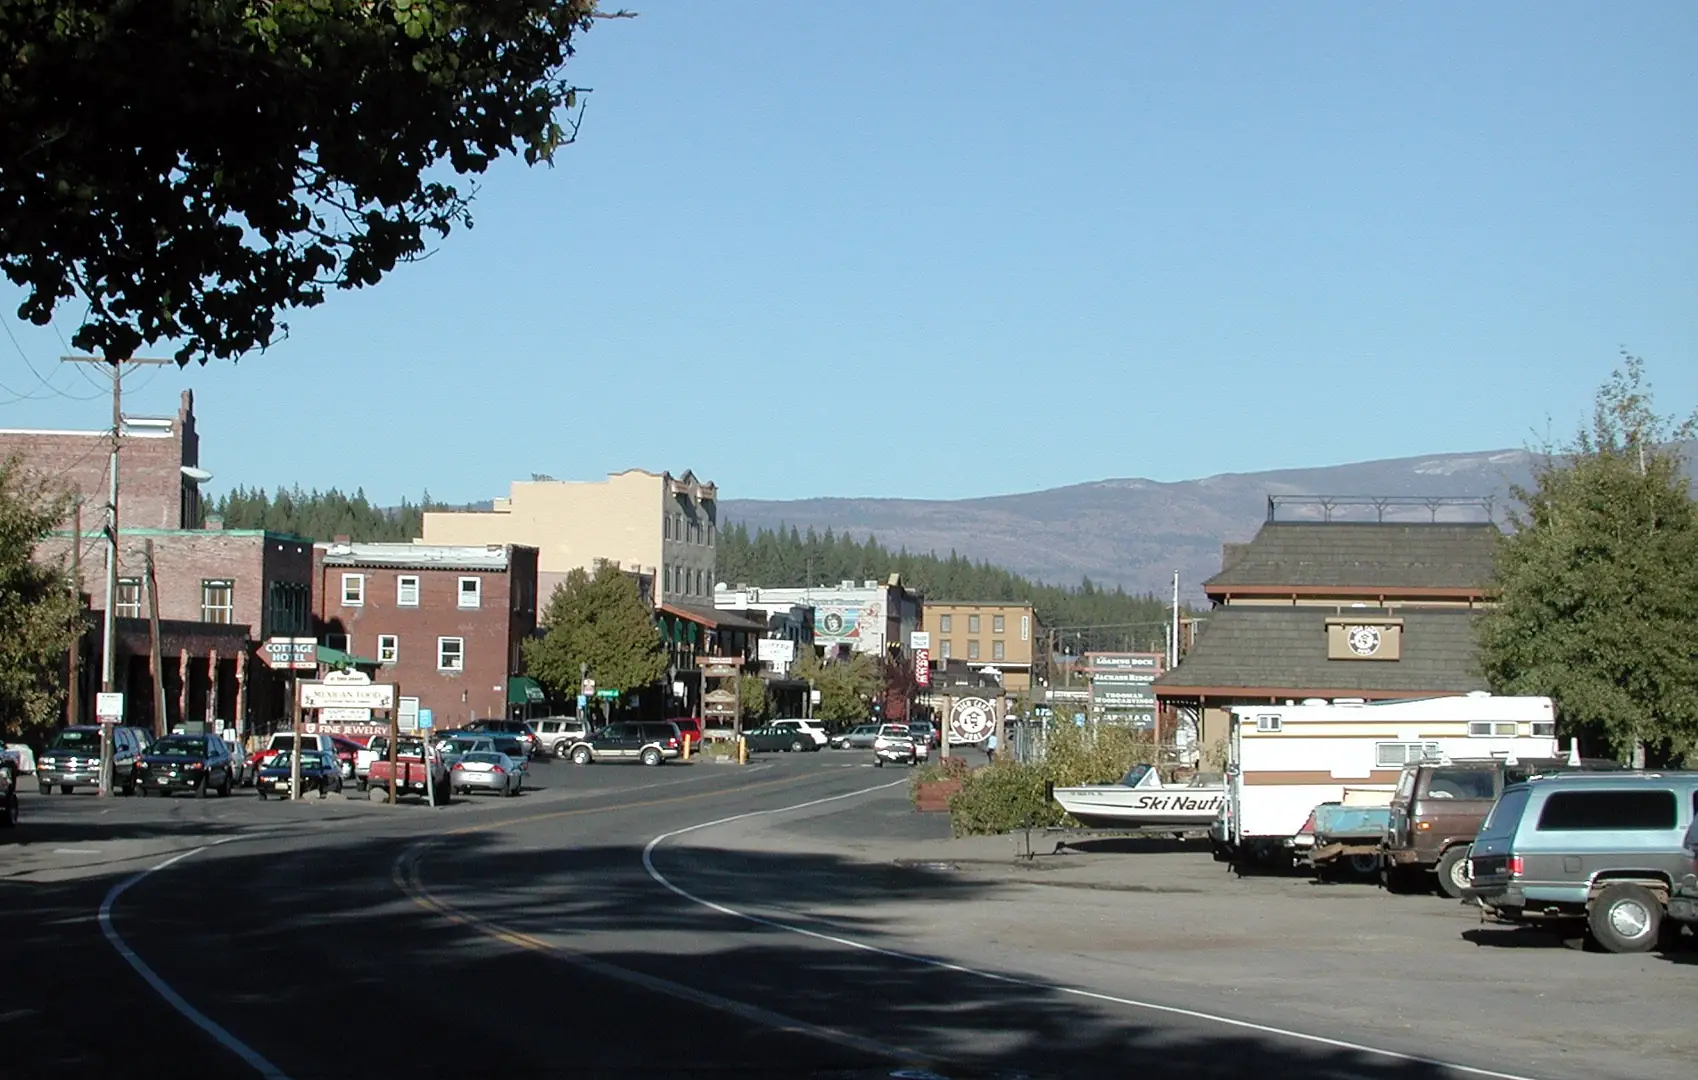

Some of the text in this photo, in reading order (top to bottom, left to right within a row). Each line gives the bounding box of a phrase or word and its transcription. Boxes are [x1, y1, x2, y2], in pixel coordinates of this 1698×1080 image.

[265, 644, 313, 653] COTTAGE
[314, 690, 381, 698] MEXICAN FOOD
[319, 725, 341, 733] FINE
[343, 725, 388, 735] JEWELRY
[1138, 796, 1170, 810] Ski
